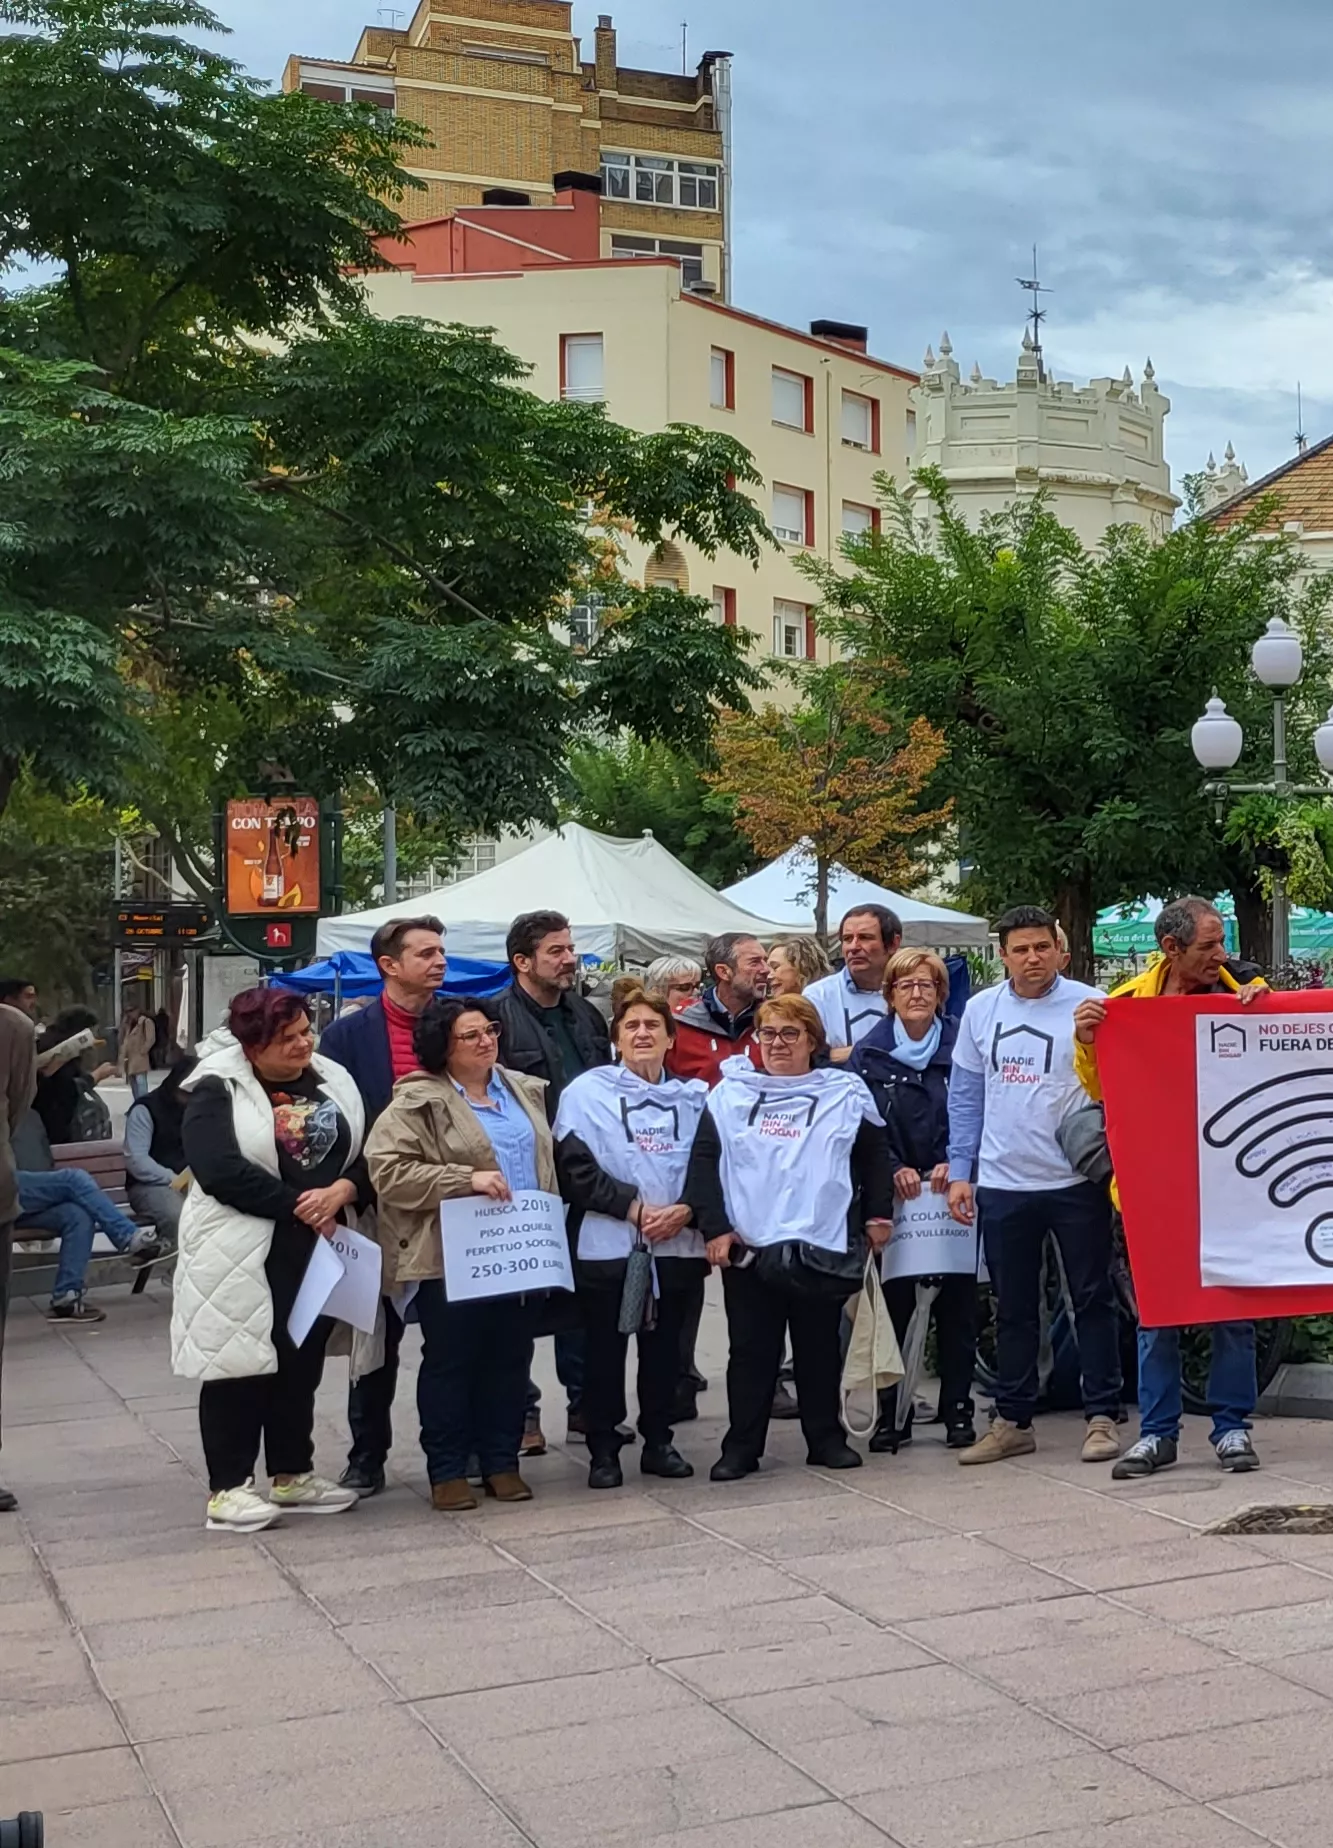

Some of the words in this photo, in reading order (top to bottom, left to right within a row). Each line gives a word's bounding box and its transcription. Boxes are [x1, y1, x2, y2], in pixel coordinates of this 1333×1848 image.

[232, 816, 261, 829] CON
[1258, 1024, 1280, 1035] NO
[1282, 1022, 1326, 1035] DEJES
[1260, 1038, 1312, 1052] FUERA
[1002, 1056, 1035, 1066] NADIE
[1002, 1065, 1020, 1074] SIN
[1001, 1074, 1040, 1084] HOGAR
[763, 1112, 798, 1122] NADIE
[760, 1120, 782, 1128] SIN
[758, 1127, 802, 1138] HOGAR
[474, 1205, 518, 1218] HUESCA
[520, 1199, 551, 1212] 2019
[480, 1227, 505, 1239] PISO
[508, 1222, 553, 1235] ALQUILER
[465, 1242, 522, 1257] PERPETUO
[471, 1257, 539, 1279] 250-300
